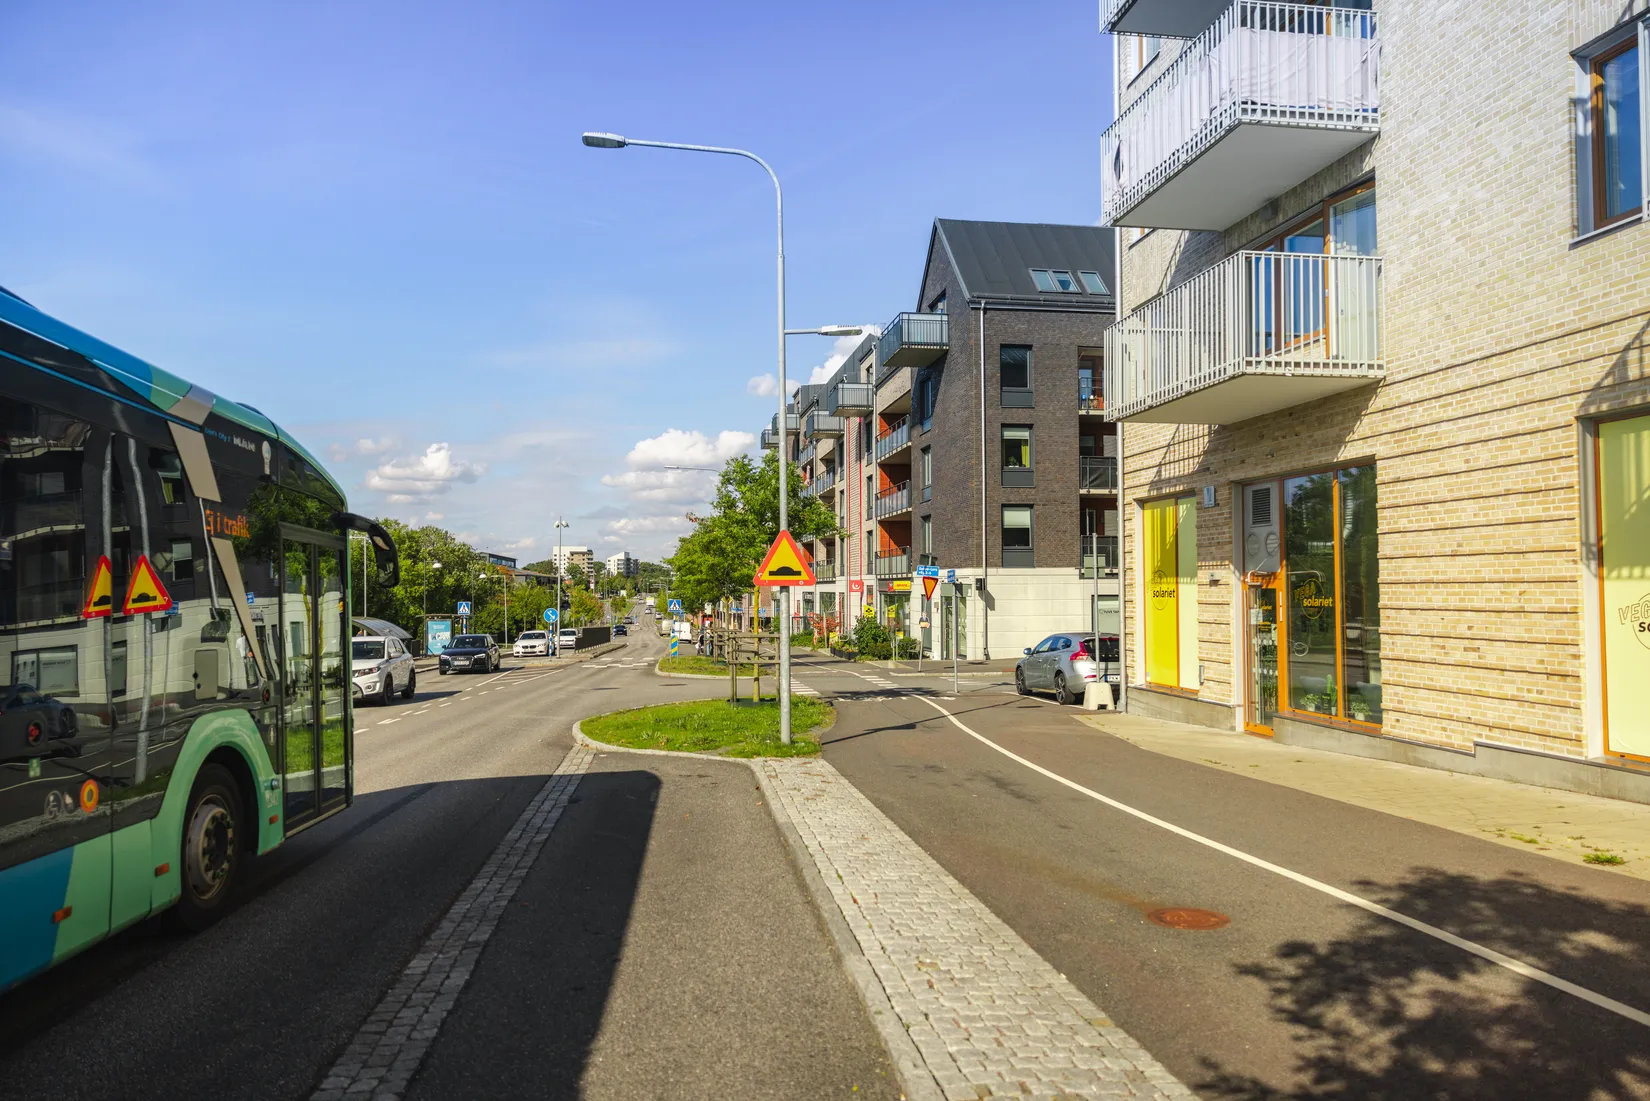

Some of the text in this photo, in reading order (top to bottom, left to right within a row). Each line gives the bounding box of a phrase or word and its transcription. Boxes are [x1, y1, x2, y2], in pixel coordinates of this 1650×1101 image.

[1152, 586, 1175, 598] solariet
[1293, 581, 1316, 603] VEGA
[1302, 594, 1333, 607] solariet
